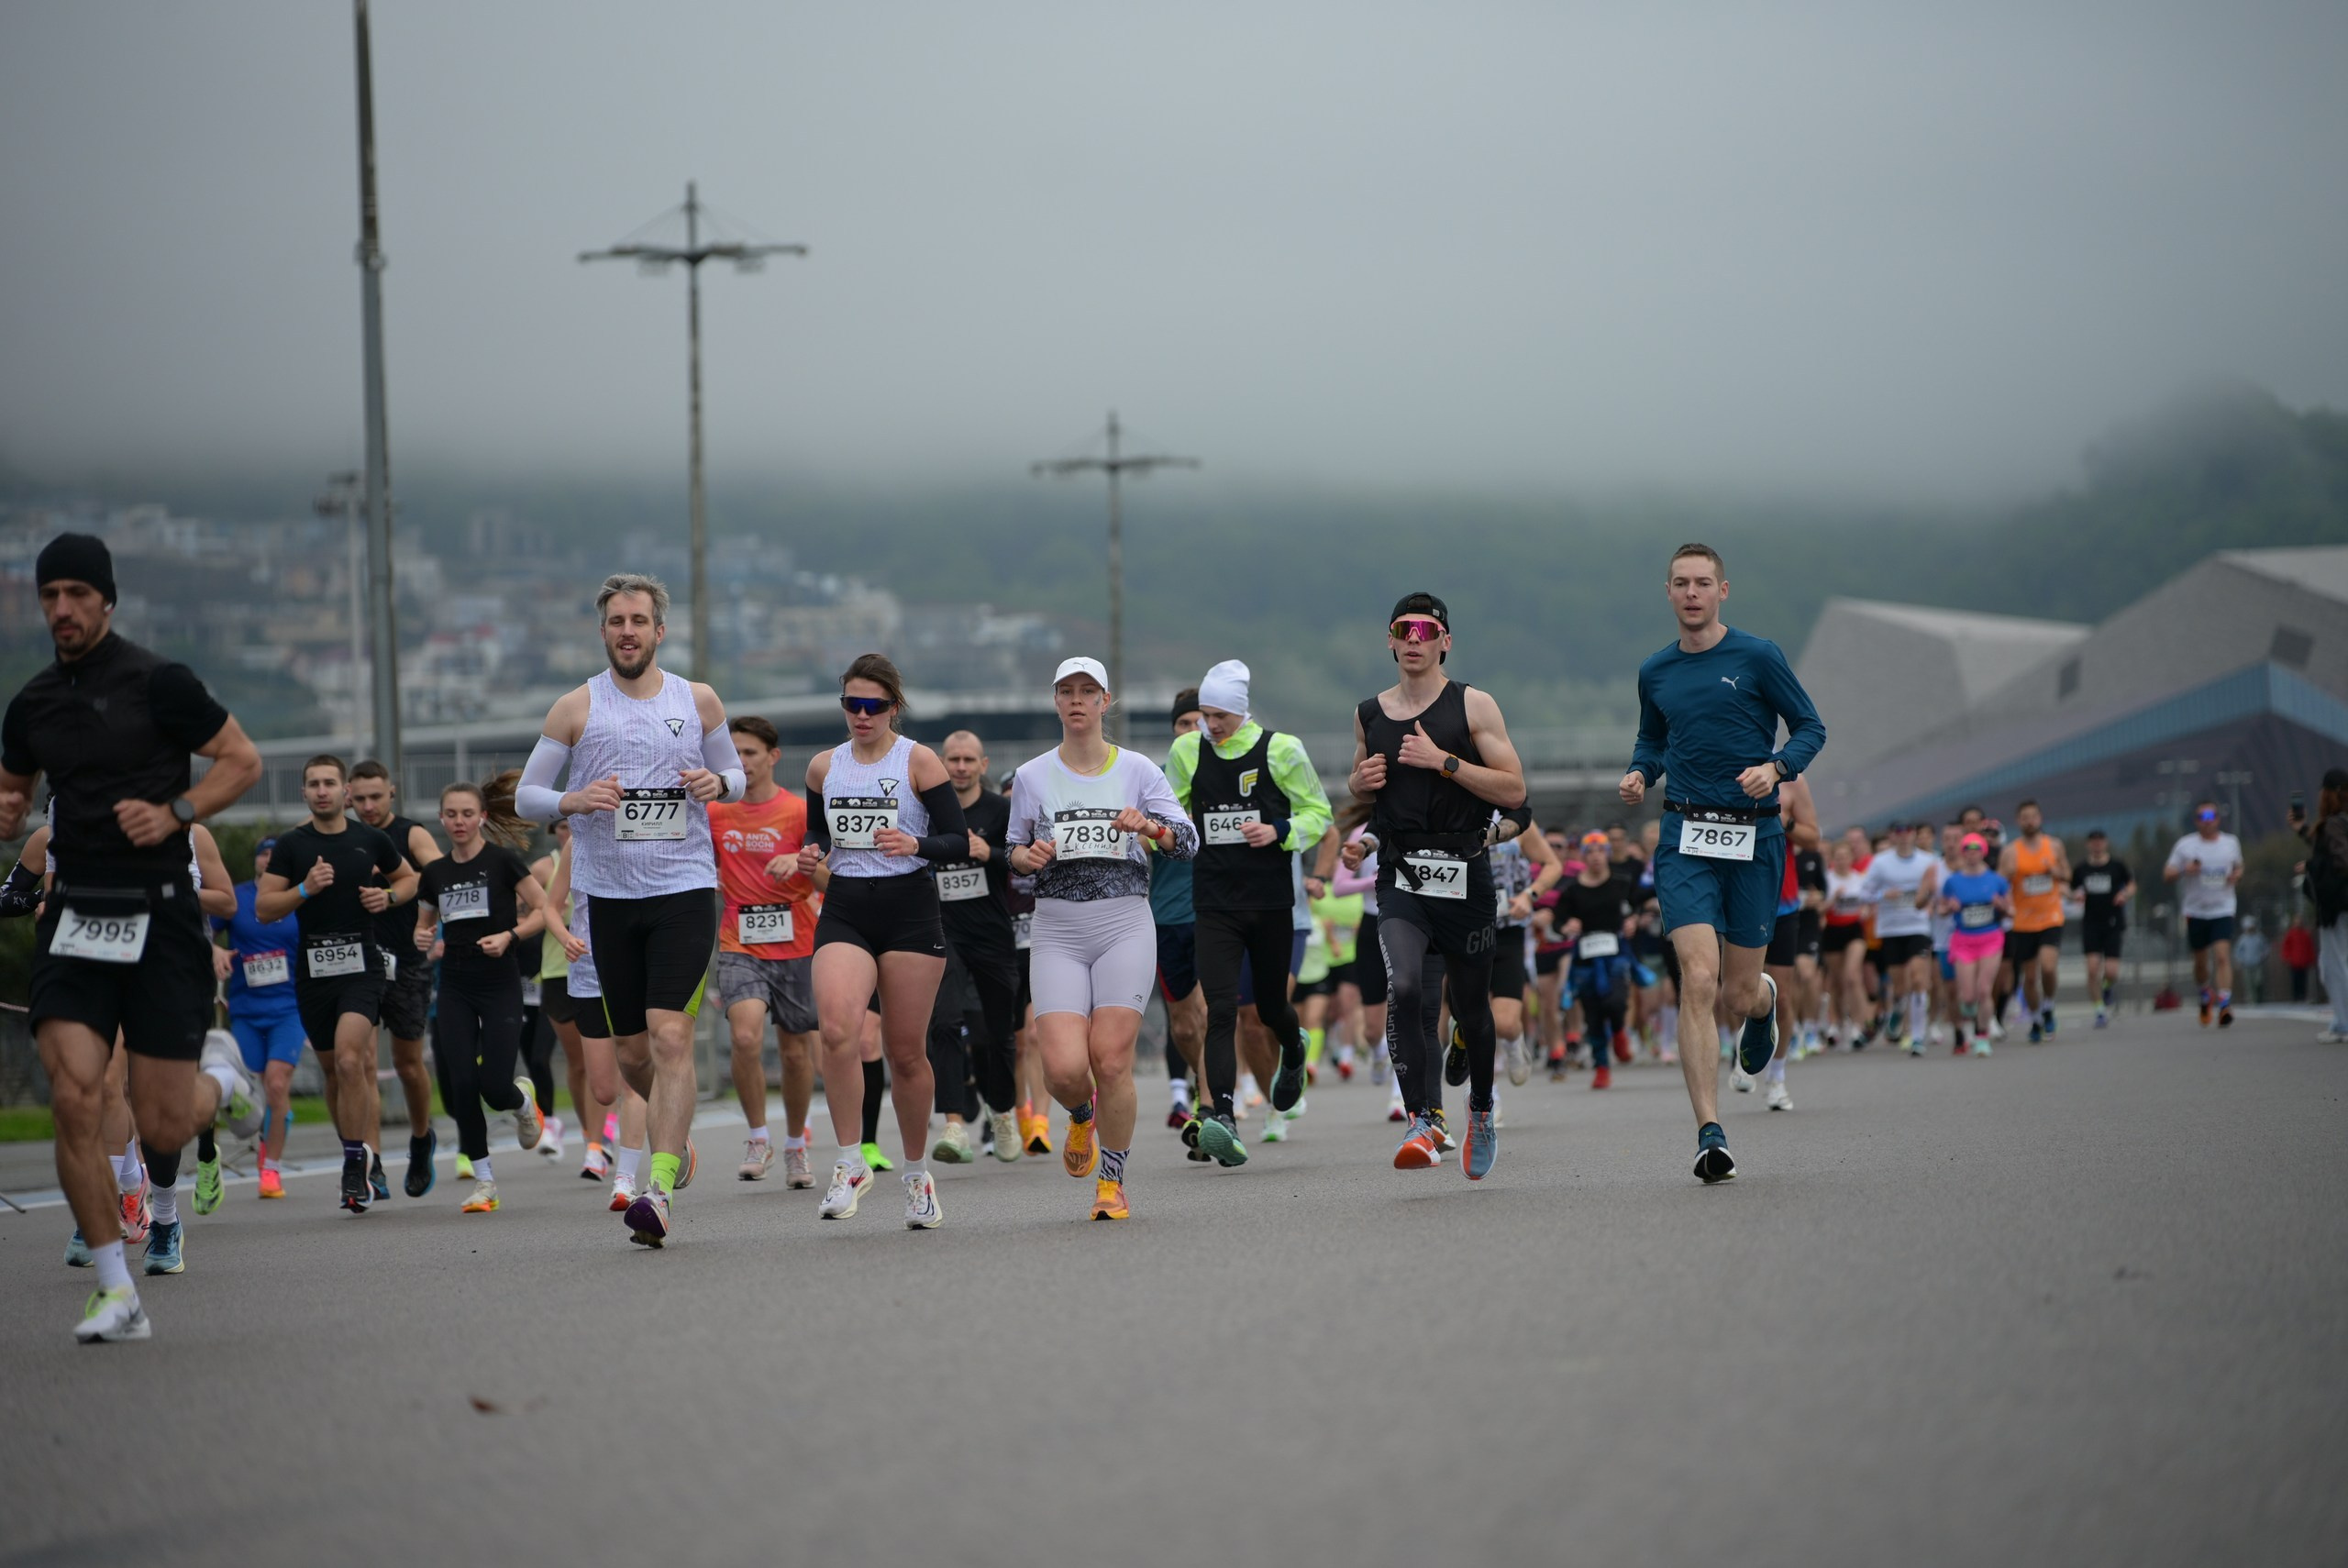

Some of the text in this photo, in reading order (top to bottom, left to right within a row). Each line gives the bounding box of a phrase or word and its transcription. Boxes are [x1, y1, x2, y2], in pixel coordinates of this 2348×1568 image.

[625, 802, 679, 821] 6777
[836, 815, 889, 833] 8373
[1063, 825, 1120, 844] 7830
[1691, 827, 1747, 846] 7867
[942, 873, 980, 889] 8357
[446, 889, 480, 907] 7718
[746, 913, 784, 929] 8231
[69, 918, 138, 944] 7995
[314, 945, 358, 963] 6954
[1387, 1013, 1400, 1061] VENUM
